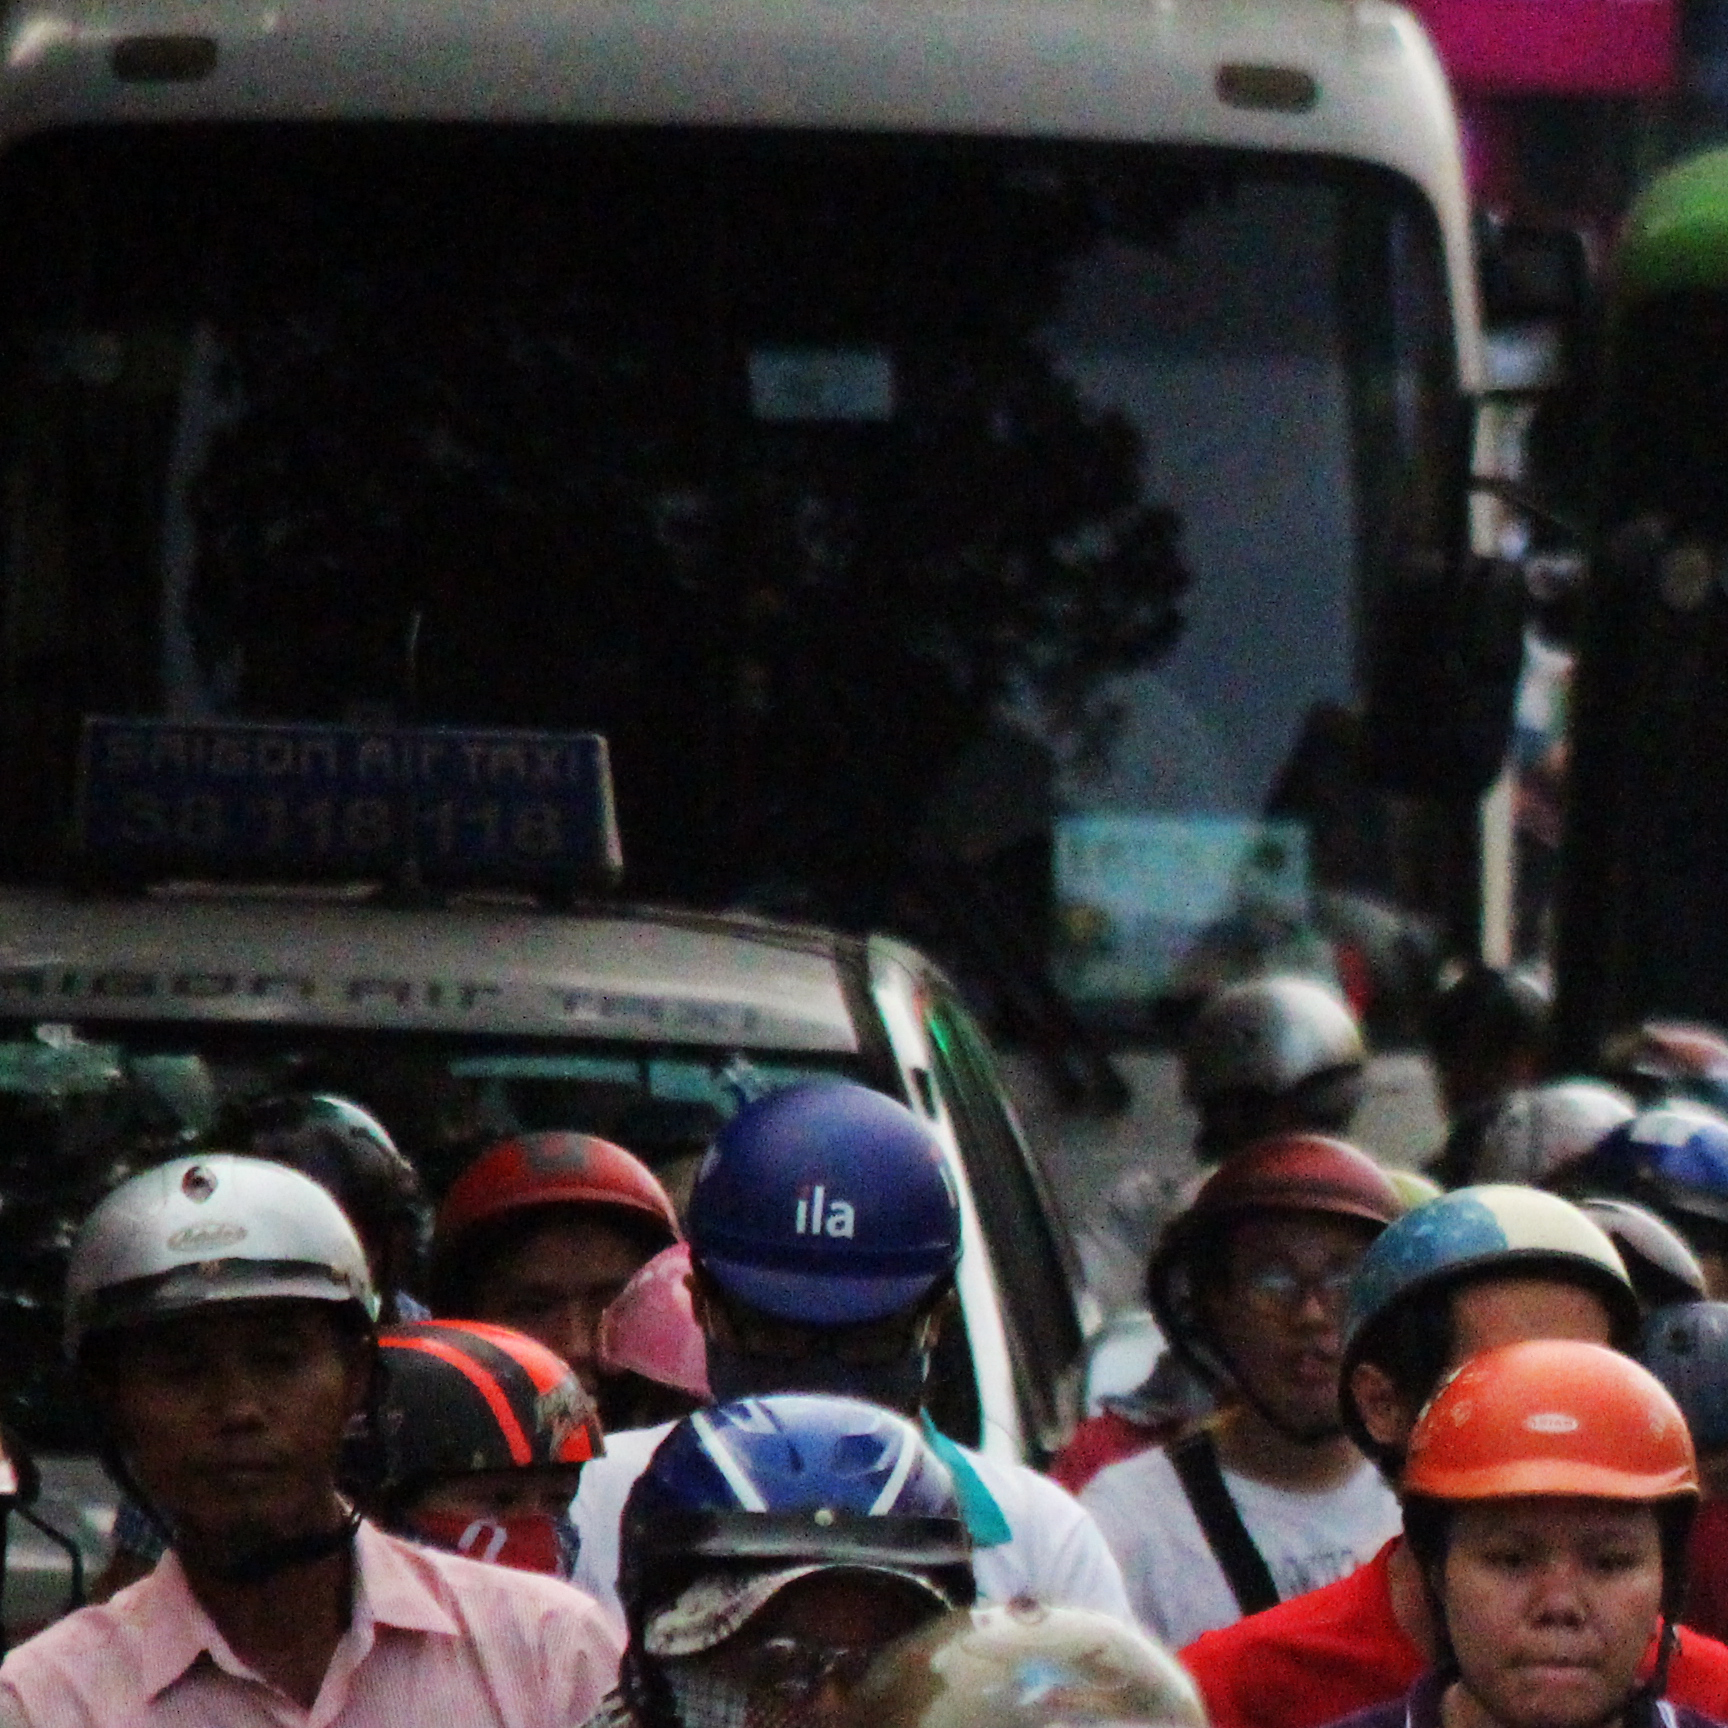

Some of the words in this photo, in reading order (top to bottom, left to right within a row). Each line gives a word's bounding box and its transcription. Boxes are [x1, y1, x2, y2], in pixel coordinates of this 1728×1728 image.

[102, 733, 337, 777] SAIGON
[464, 741, 580, 781] TAXI
[796, 1184, 856, 1240] ila
